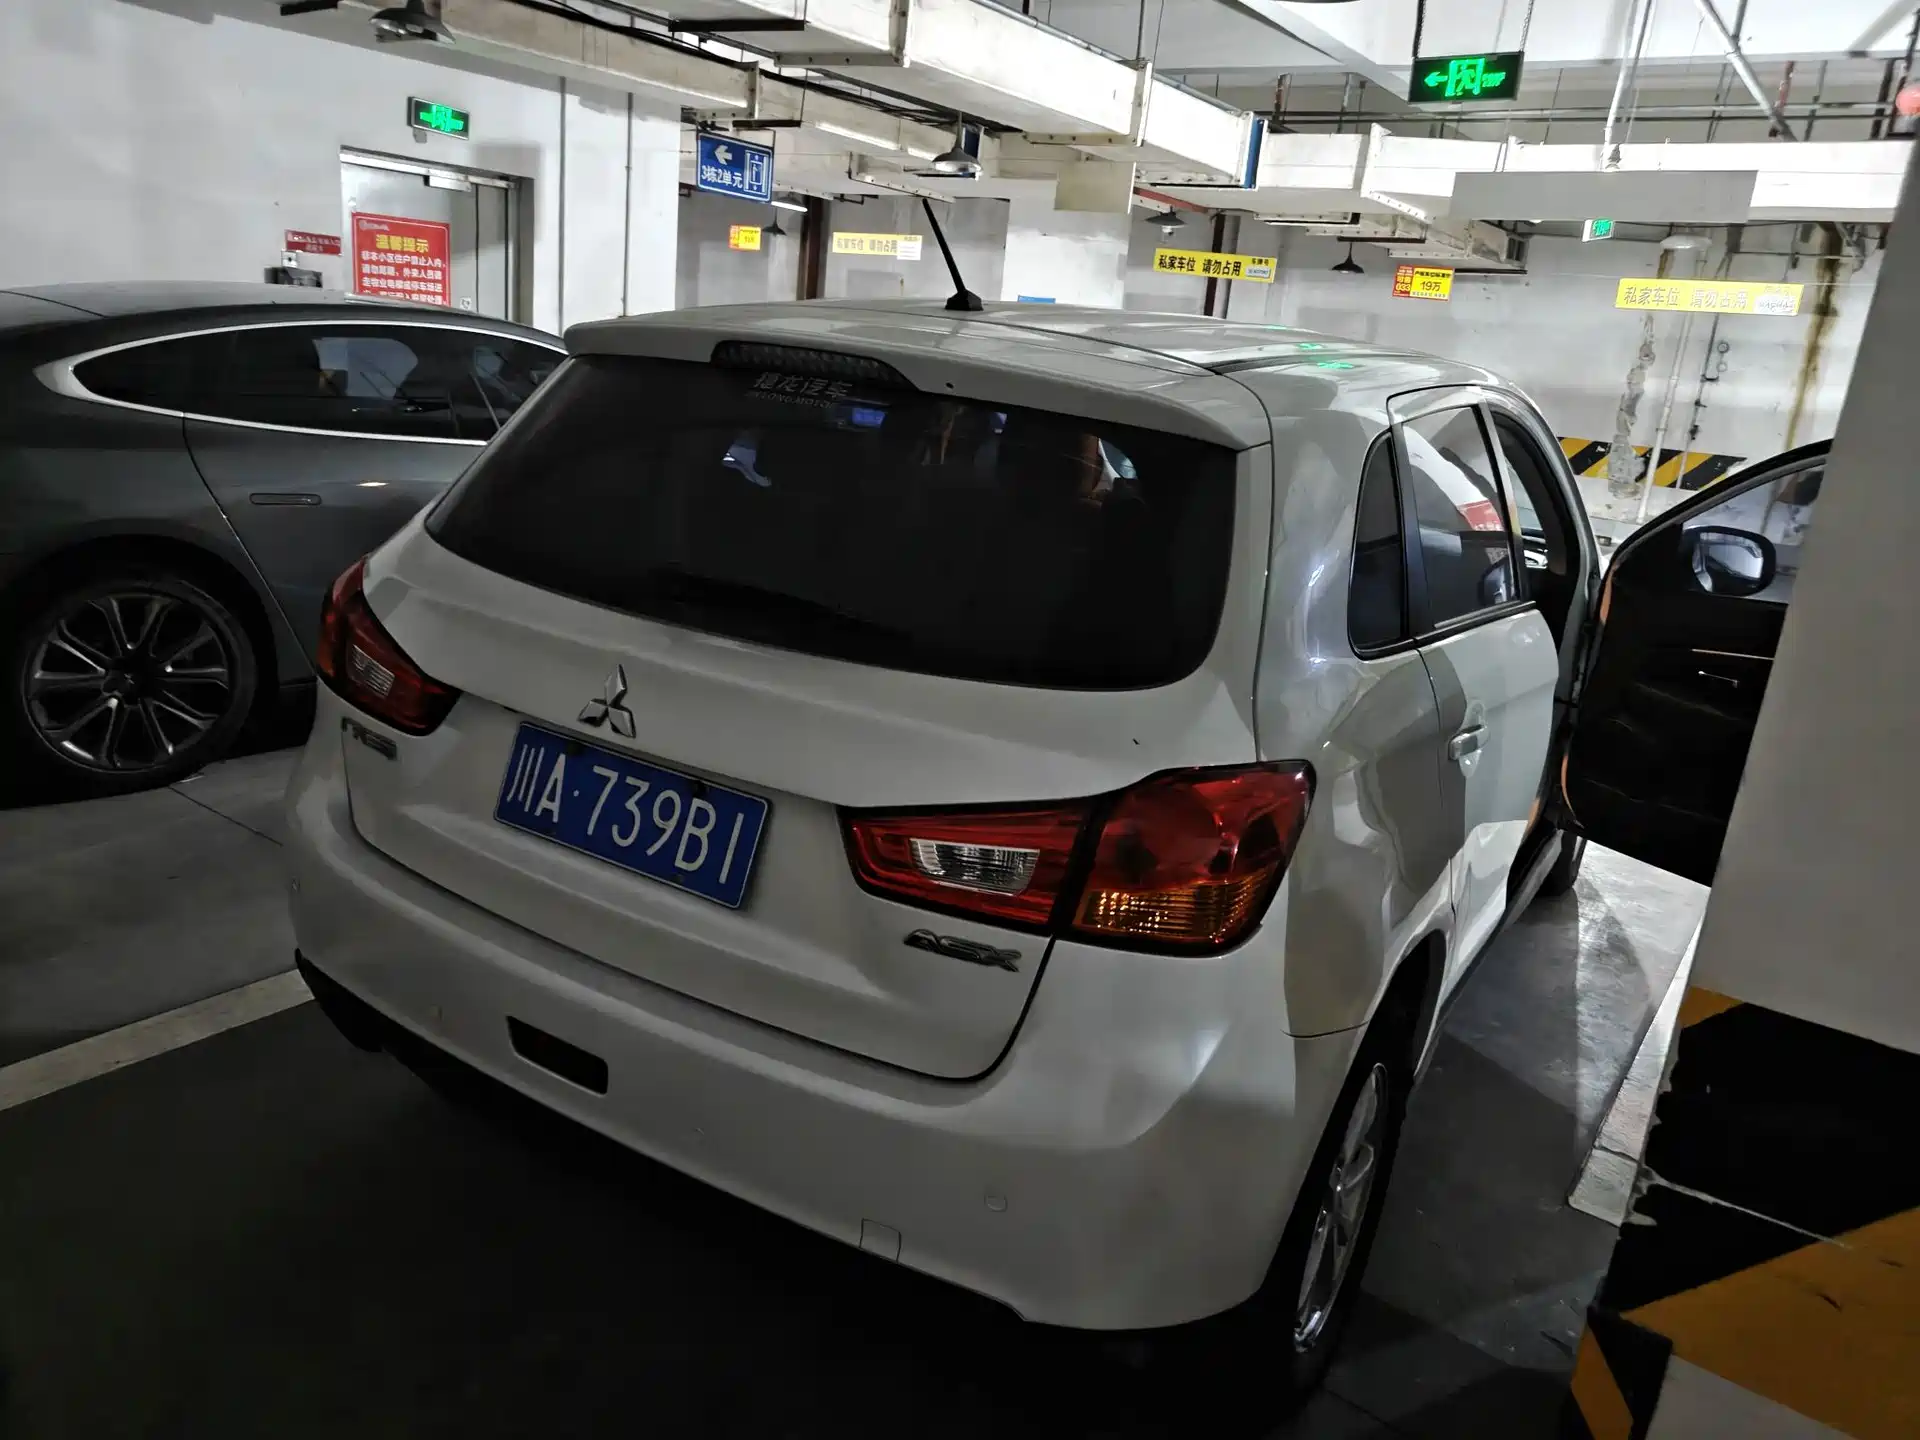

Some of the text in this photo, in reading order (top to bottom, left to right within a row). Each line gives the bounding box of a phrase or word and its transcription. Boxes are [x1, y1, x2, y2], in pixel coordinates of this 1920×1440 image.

[701, 164, 744, 189] 3栋2单元
[376, 234, 429, 253] 温馨提示
[1158, 254, 1196, 272] 私家车位
[1202, 258, 1242, 276] 请勿占用
[1420, 280, 1443, 292] 19万
[1623, 285, 1681, 307] 私家车位
